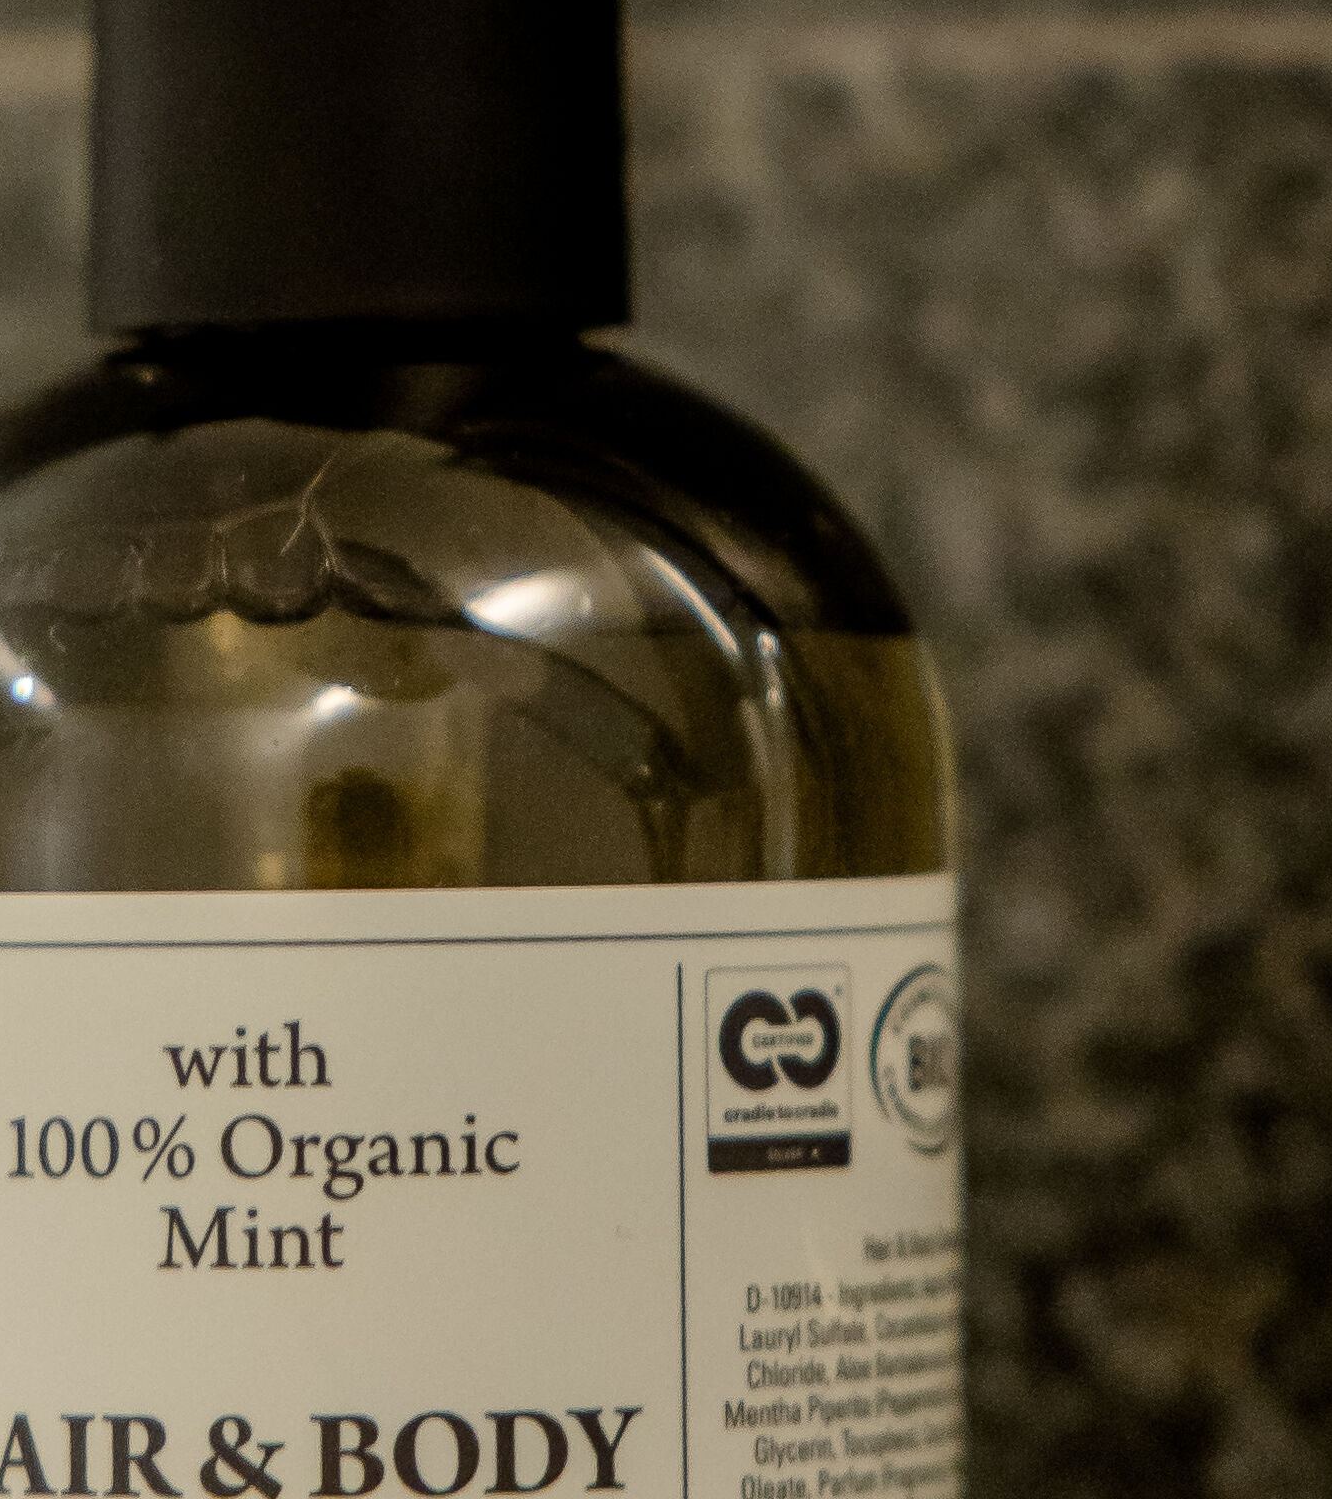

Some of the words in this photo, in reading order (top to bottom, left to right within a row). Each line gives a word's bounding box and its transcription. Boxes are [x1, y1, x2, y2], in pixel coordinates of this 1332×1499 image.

[164, 1020, 331, 1089] with
[8, 1115, 197, 1182] 100%
[220, 1114, 520, 1202] Organic
[158, 1205, 346, 1270] Mint
[738, 1321, 802, 1354] Lauryl
[724, 1399, 801, 1429] Mentha
[309, 1406, 643, 1499] BODY
